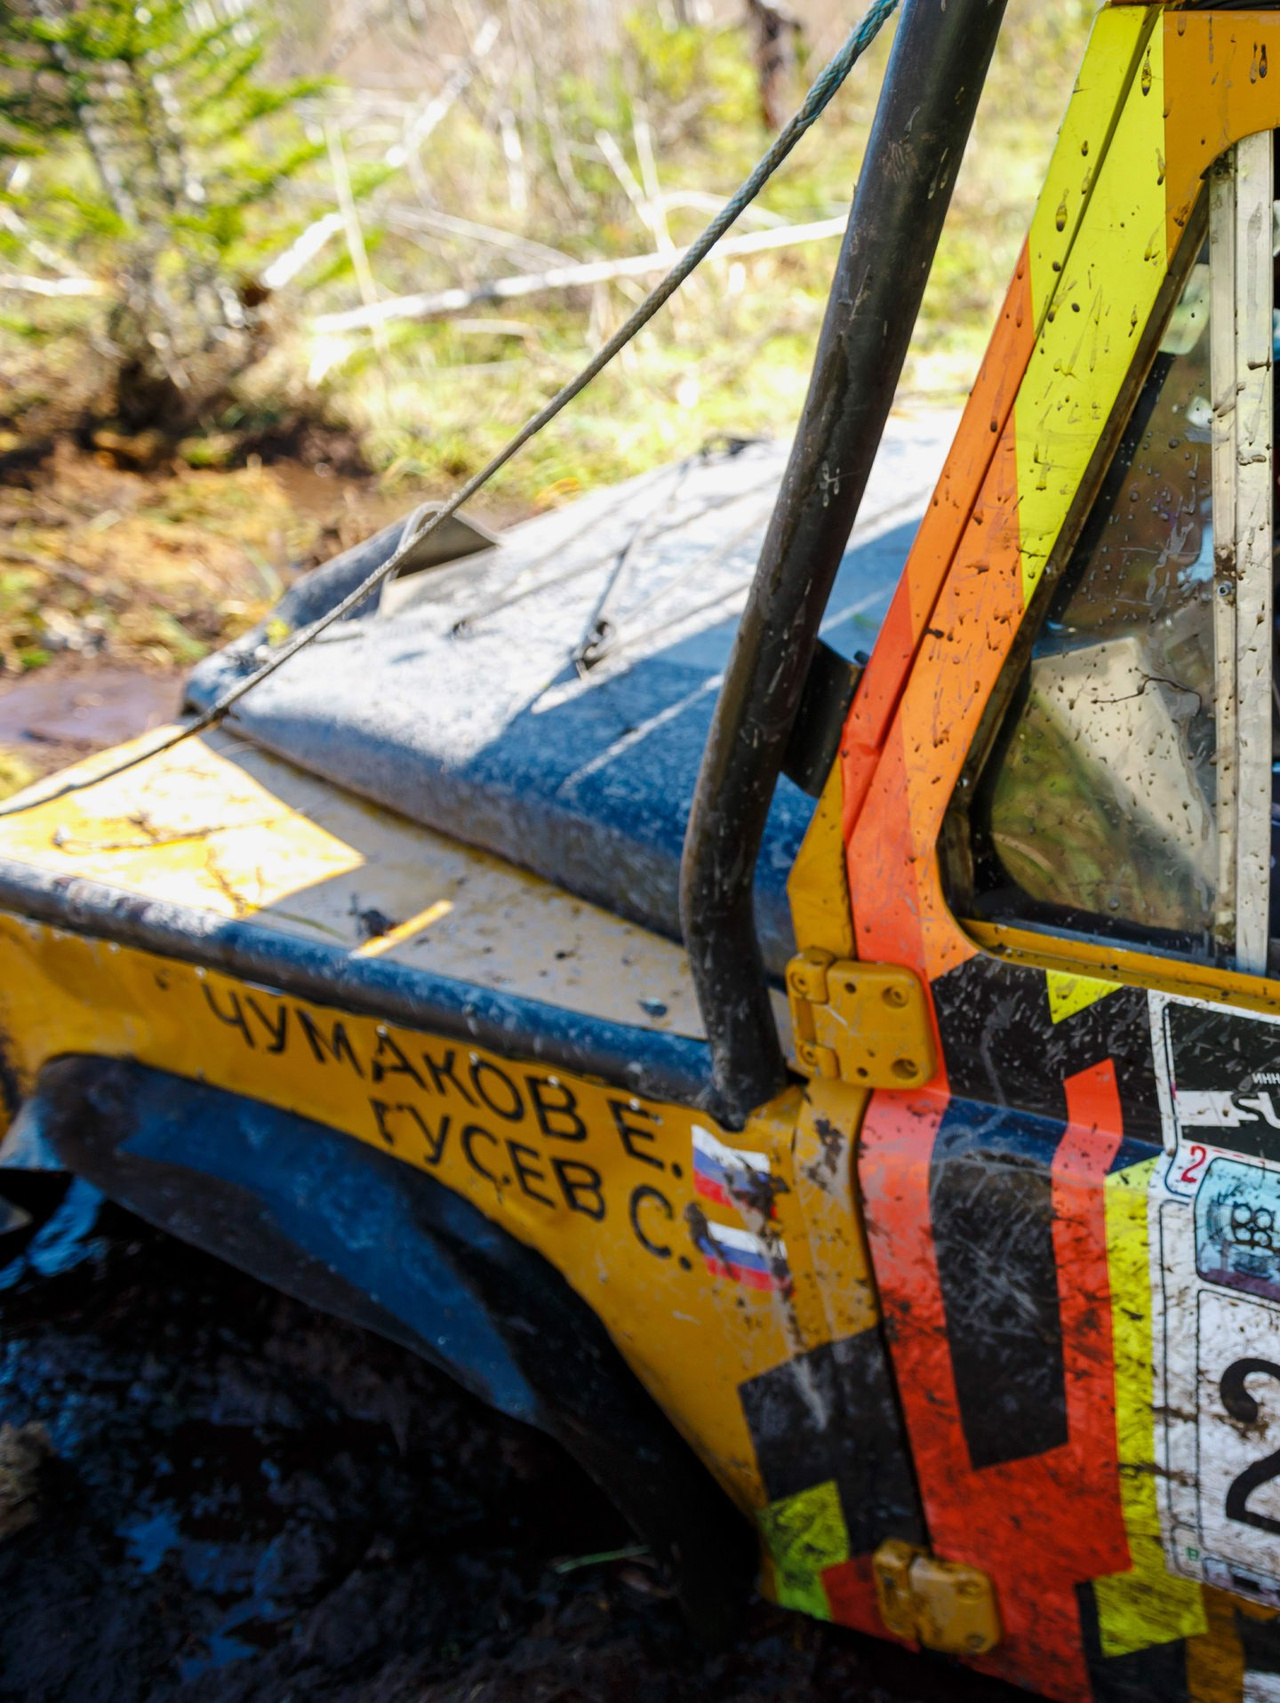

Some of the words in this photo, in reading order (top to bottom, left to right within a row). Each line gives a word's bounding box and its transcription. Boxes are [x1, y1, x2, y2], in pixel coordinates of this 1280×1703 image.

[203, 983, 588, 1142] ЧУМАКОВ
[607, 1100, 682, 1178] Е.
[369, 1097, 606, 1222] ГУСЕВ
[630, 1183, 692, 1272] С.
